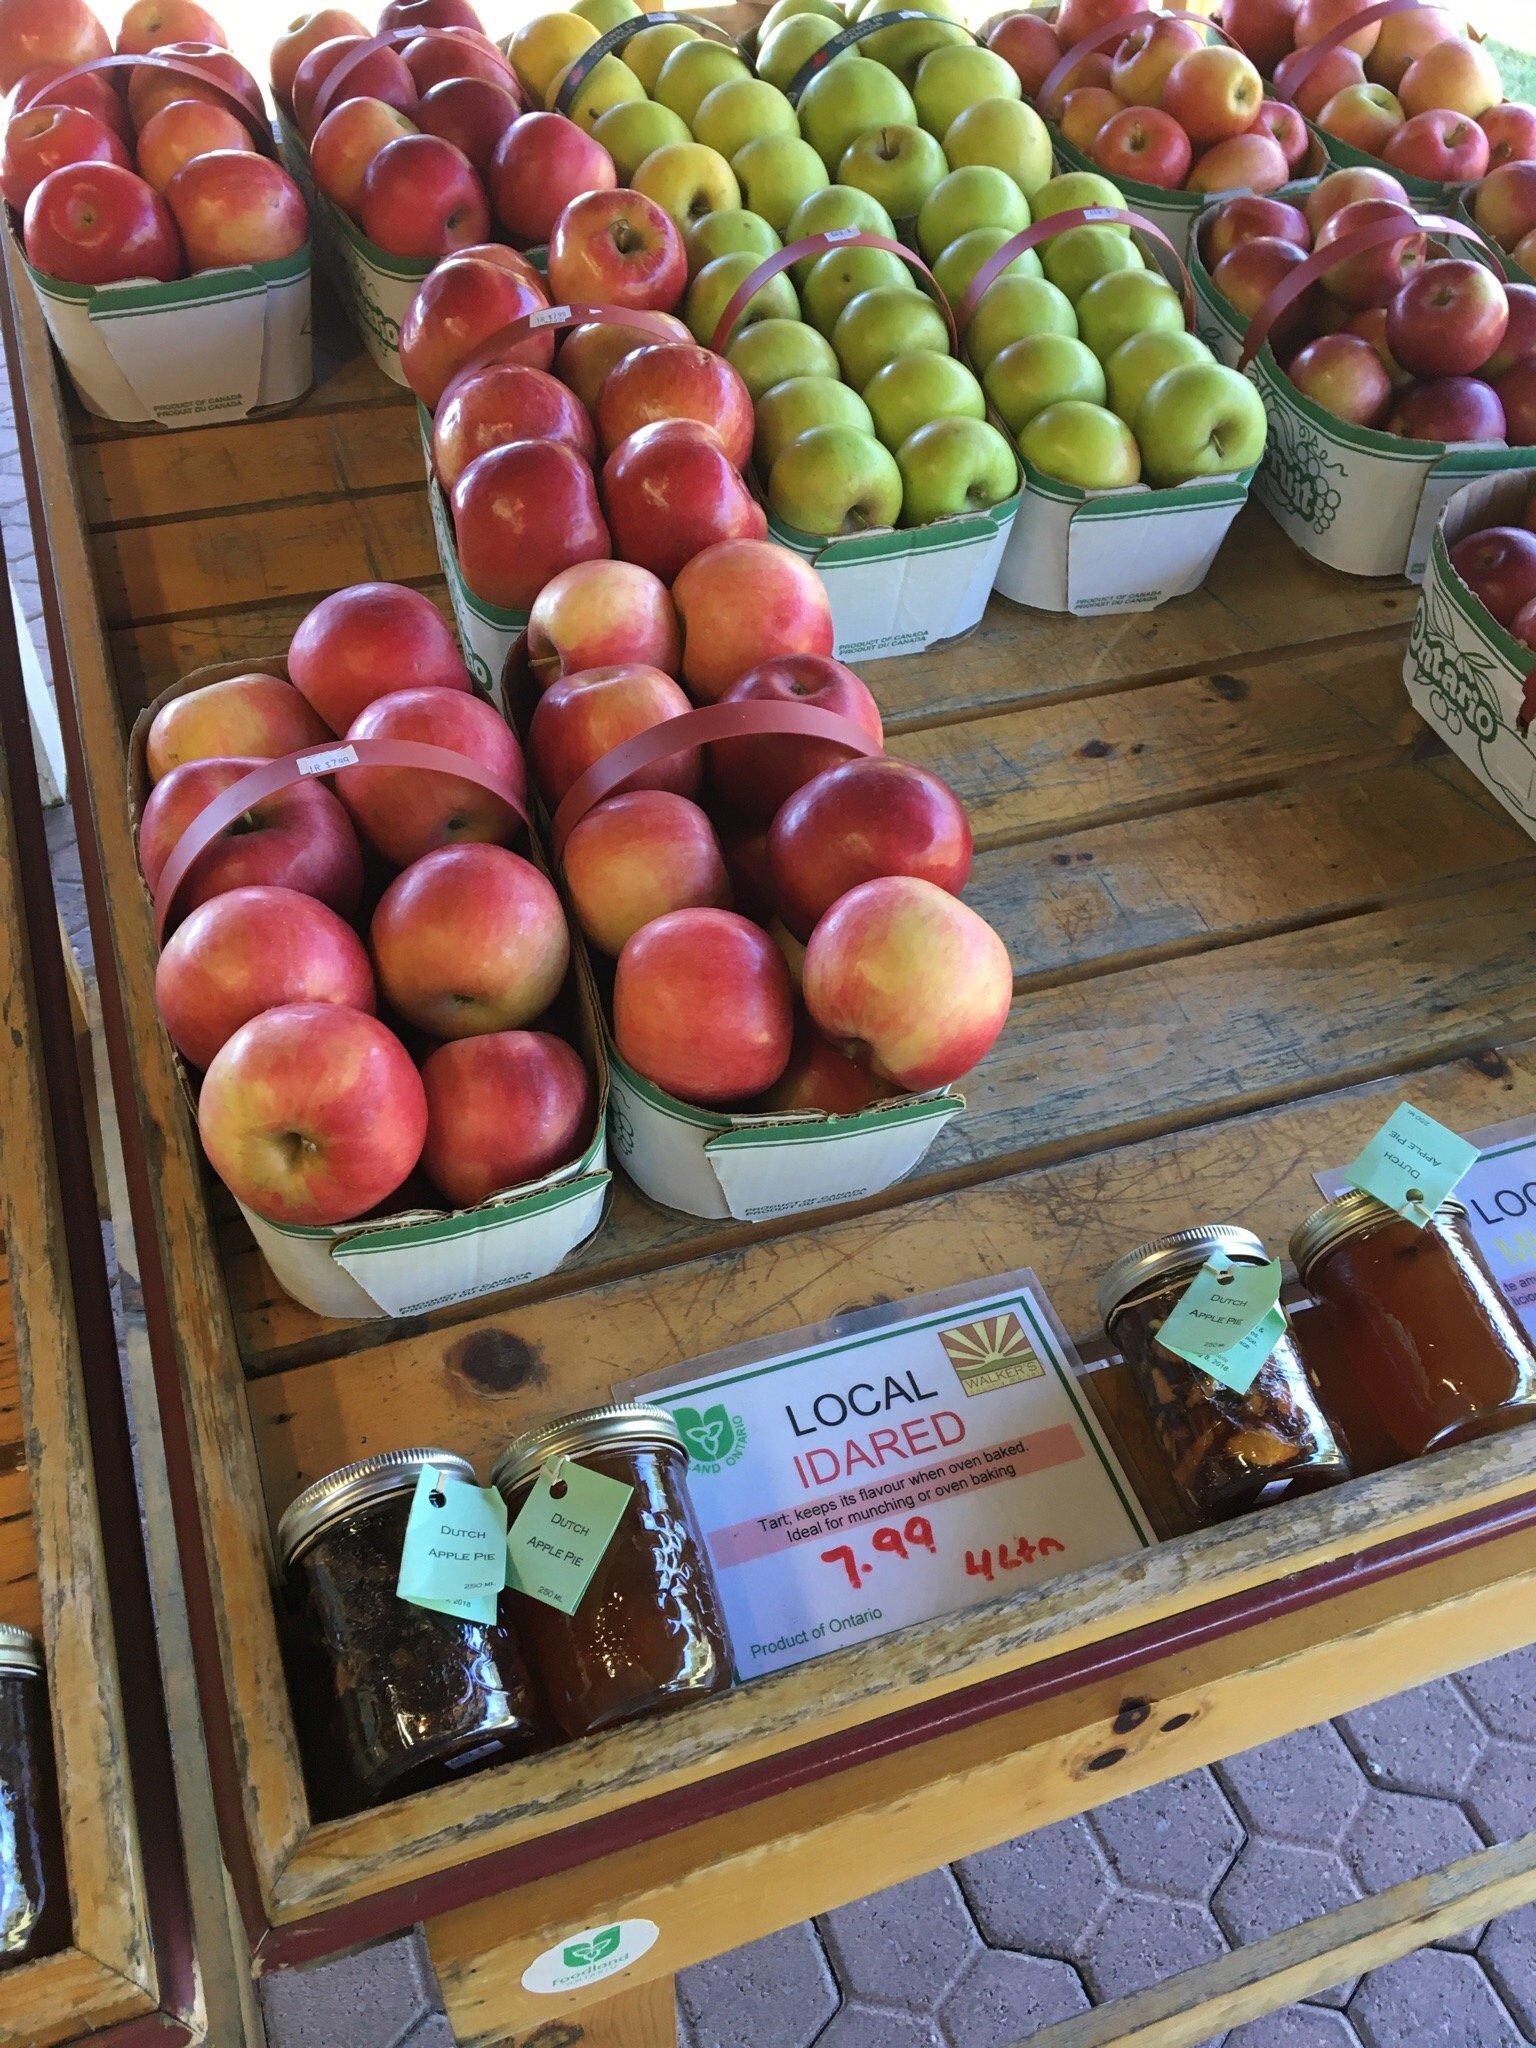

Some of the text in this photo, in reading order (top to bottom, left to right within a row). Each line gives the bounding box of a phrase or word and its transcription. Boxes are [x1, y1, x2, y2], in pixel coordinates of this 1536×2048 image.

[153, 393, 243, 412] PRODUCT OF CANADA
[838, 639, 879, 651] PRODUCT
[894, 631, 929, 641] CANADA
[840, 645, 876, 656] PRODUIT
[891, 636, 927, 647] CANADA
[1388, 1130, 1442, 1167] APPLE PIE
[1384, 1151, 1421, 1180] DUTCH
[1210, 1294, 1248, 1307] DUTCH
[1189, 1309, 1244, 1326] APPLE PIE
[965, 1362, 1039, 1390] WALKER'S
[785, 1370, 938, 1437] LOCAL
[726, 1415, 747, 1466] ONTARIO
[793, 1411, 966, 1489] IDARED
[758, 1441, 1029, 1532] Tart; keeps its flavour when oven baked.
[787, 1464, 1017, 1543] Ideal for munching or oven baking
[441, 1525, 487, 1539] DUTCH
[551, 1513, 590, 1536] DUTCH
[428, 1548, 495, 1561] APPLE PIE
[527, 1536, 584, 1567] APPLE PIE
[820, 1516, 937, 1589] 7.99
[537, 1585, 554, 1598] 250
[750, 1608, 883, 1659] Product of Ontario
[553, 1952, 629, 1987] Foodland
